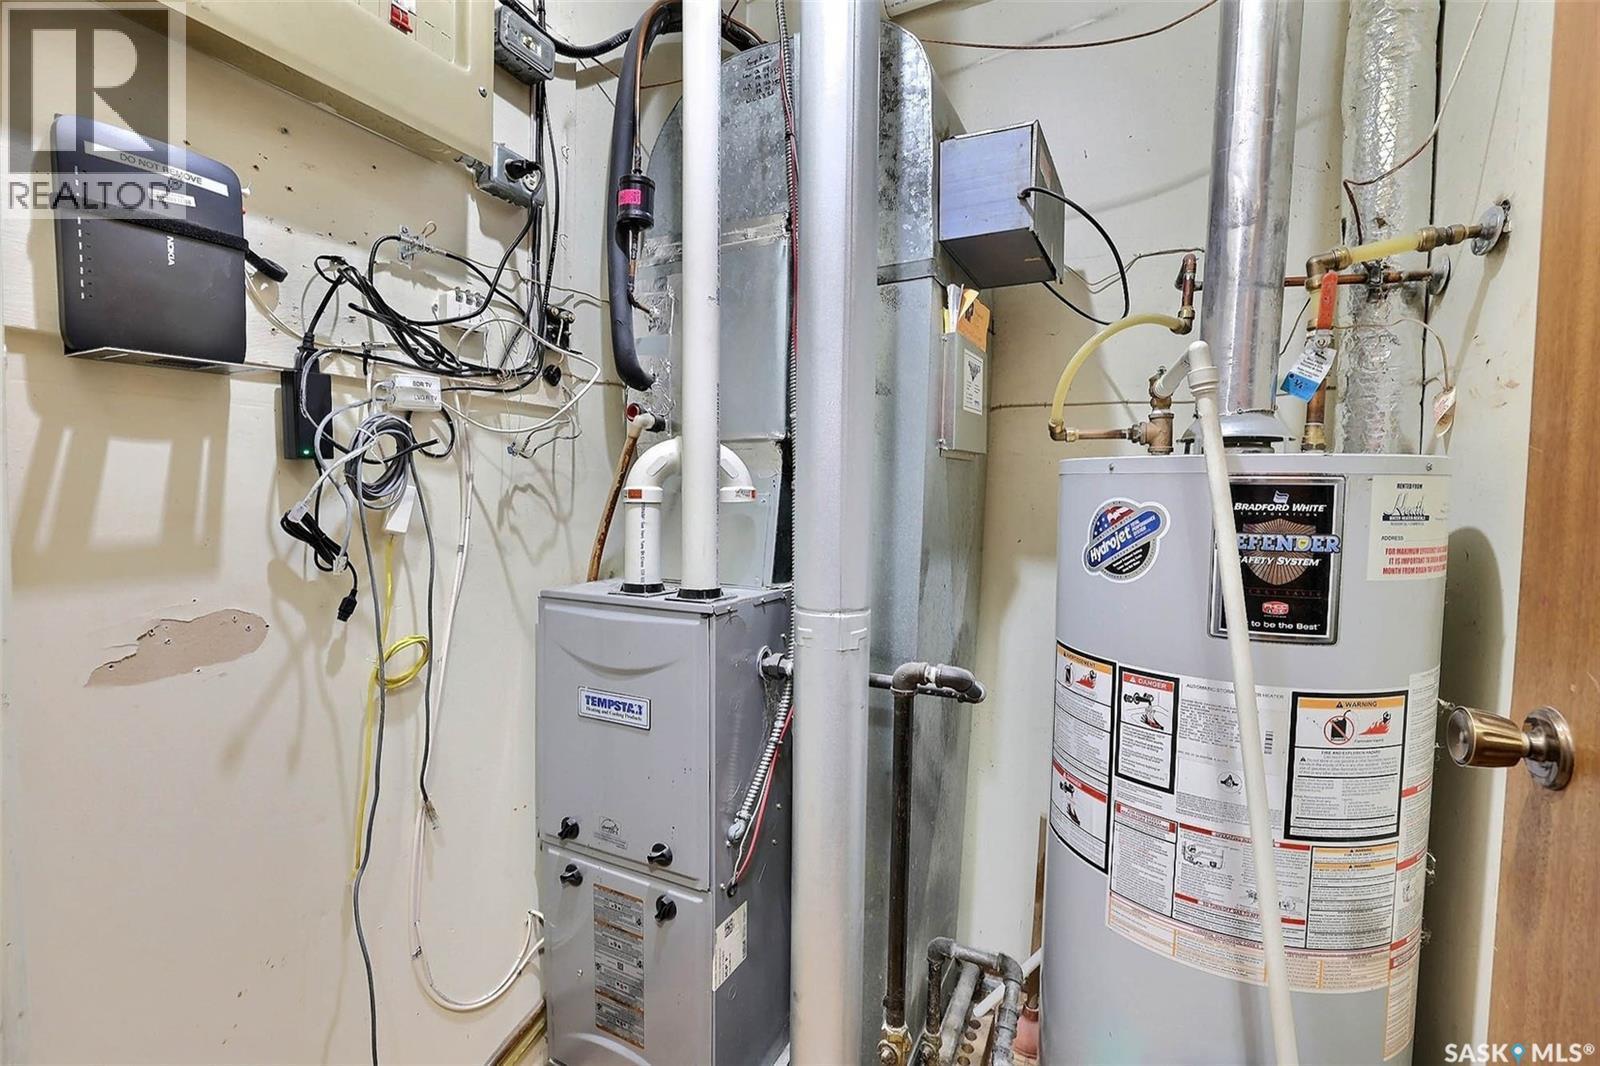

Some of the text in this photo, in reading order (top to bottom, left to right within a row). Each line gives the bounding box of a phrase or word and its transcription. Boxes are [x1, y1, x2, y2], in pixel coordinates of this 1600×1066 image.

[119, 152, 203, 186] DO NOT REMOVE
[167, 235, 176, 267] NOKIA
[1234, 502, 1327, 513] BRADFORD WHITE
[1090, 526, 1133, 562] Hydrojet
[1238, 533, 1341, 553] EFENDER
[1239, 556, 1320, 567] AFETY SYSTEM
[1251, 620, 1318, 631] to be the Best
[1138, 678, 1168, 690] DANGER
